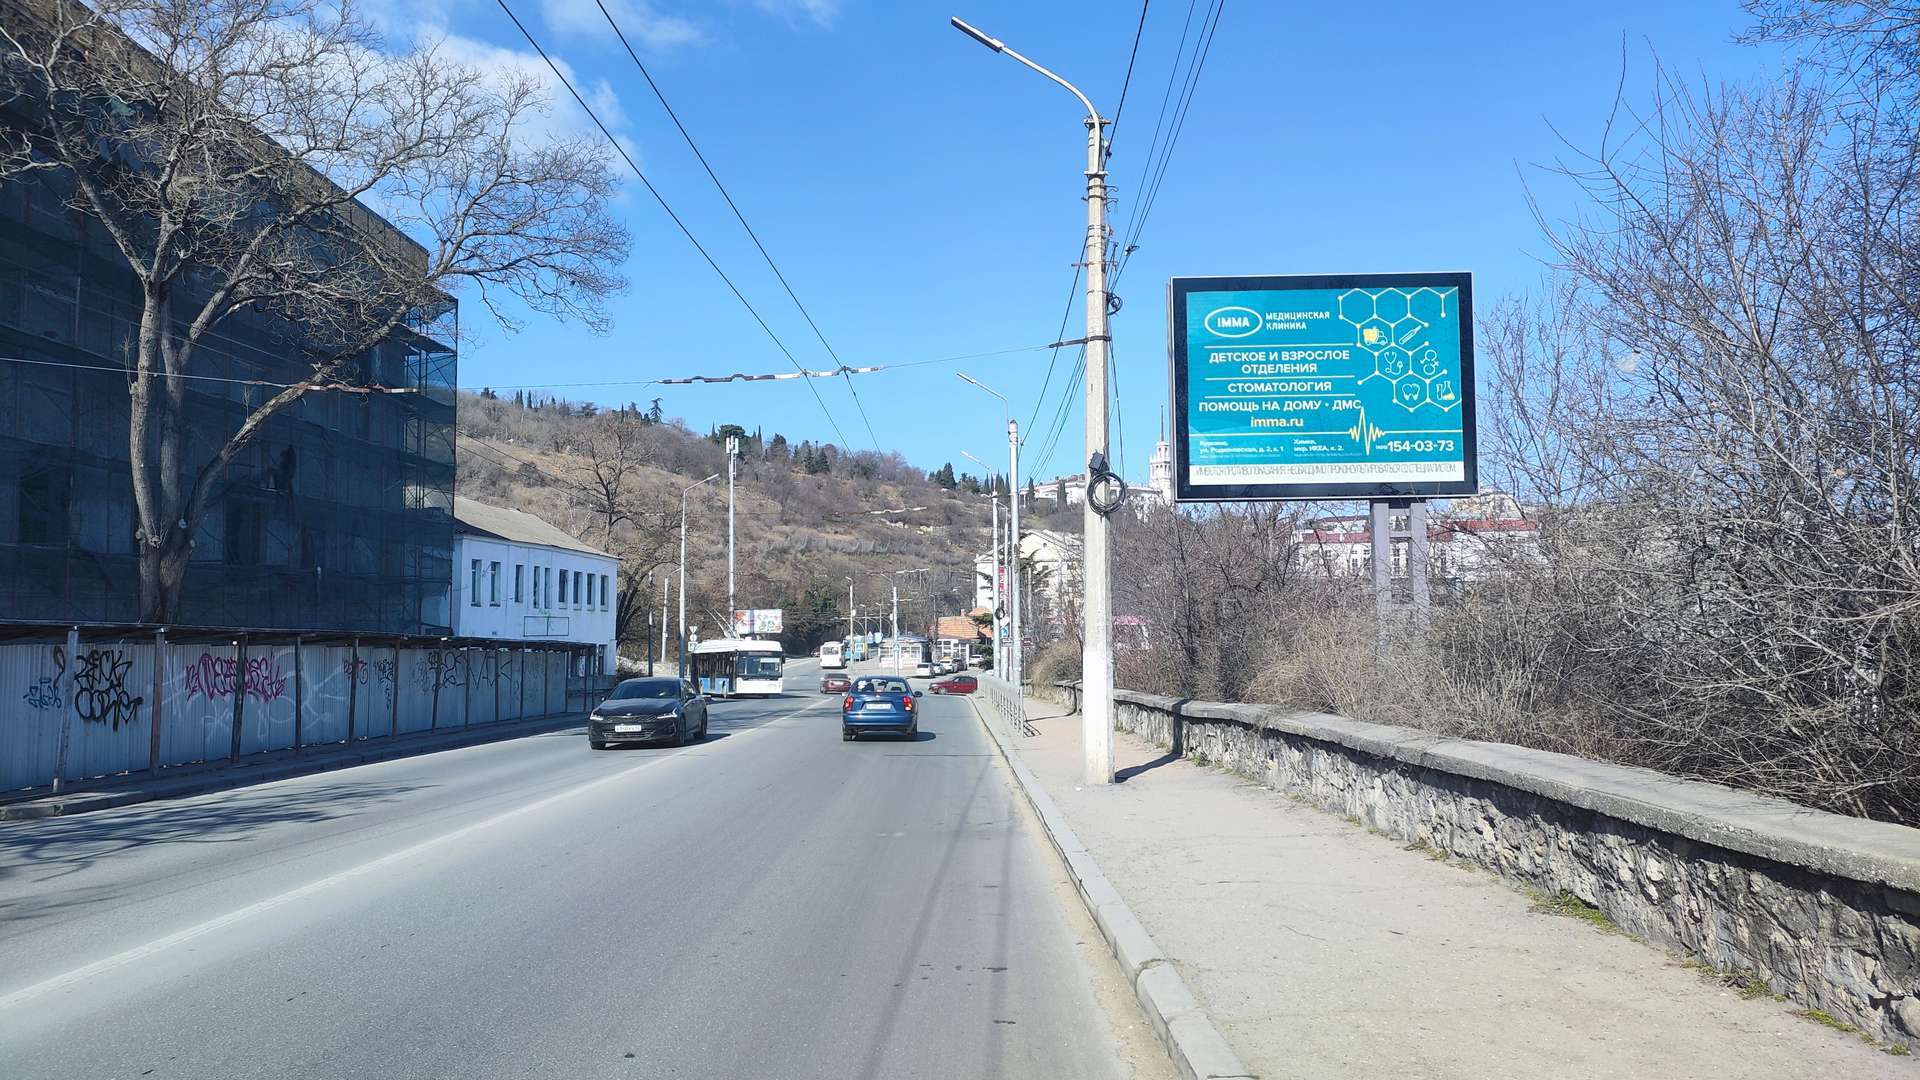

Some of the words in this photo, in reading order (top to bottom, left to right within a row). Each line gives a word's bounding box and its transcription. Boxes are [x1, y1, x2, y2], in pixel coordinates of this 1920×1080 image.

[1265, 311, 1330, 321] МЕДИЦИНСКАЯ
[1266, 321, 1307, 331] КЛИНИКА
[1209, 351, 1266, 364] ДЕТСКОЕ
[1270, 352, 1278, 361] И
[1281, 350, 1350, 361] ВЗРОСЛОЕ
[1241, 363, 1317, 375] ОТДЕЛЕНИЯ
[1227, 381, 1332, 393] СТОМАТОЛОГИЯ
[1199, 401, 1259, 412] ПОМОЩЬ
[1262, 401, 1280, 411] НА
[1283, 400, 1321, 411] ДОМУ
[1332, 400, 1361, 411] ДМС
[1250, 416, 1304, 427] imma.ru
[1387, 440, 1454, 452] 154-03-73
